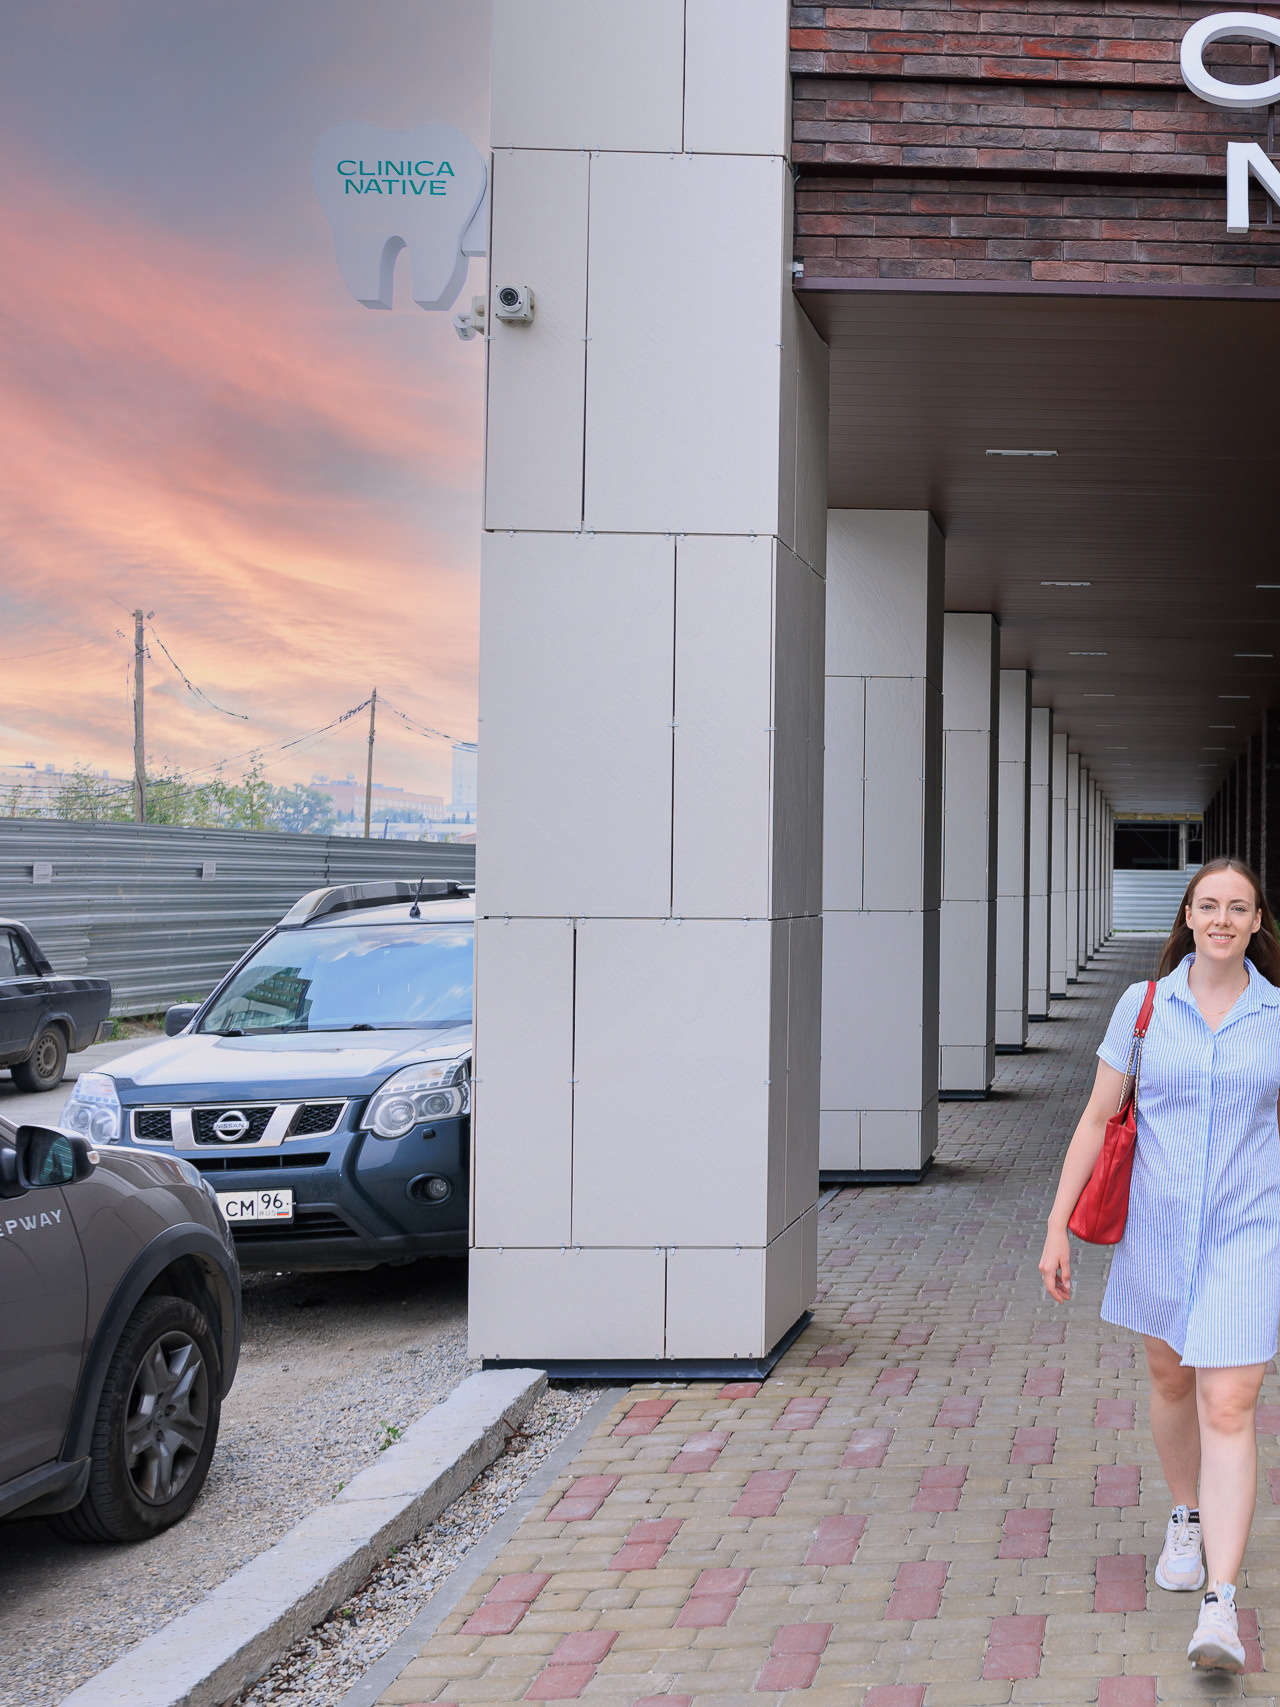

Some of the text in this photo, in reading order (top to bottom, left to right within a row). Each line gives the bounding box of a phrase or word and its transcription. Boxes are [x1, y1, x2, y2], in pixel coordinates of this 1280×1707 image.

[336, 160, 456, 177] CLINICA
[344, 178, 448, 196] NATIVE
[261, 1193, 283, 1209] 96
